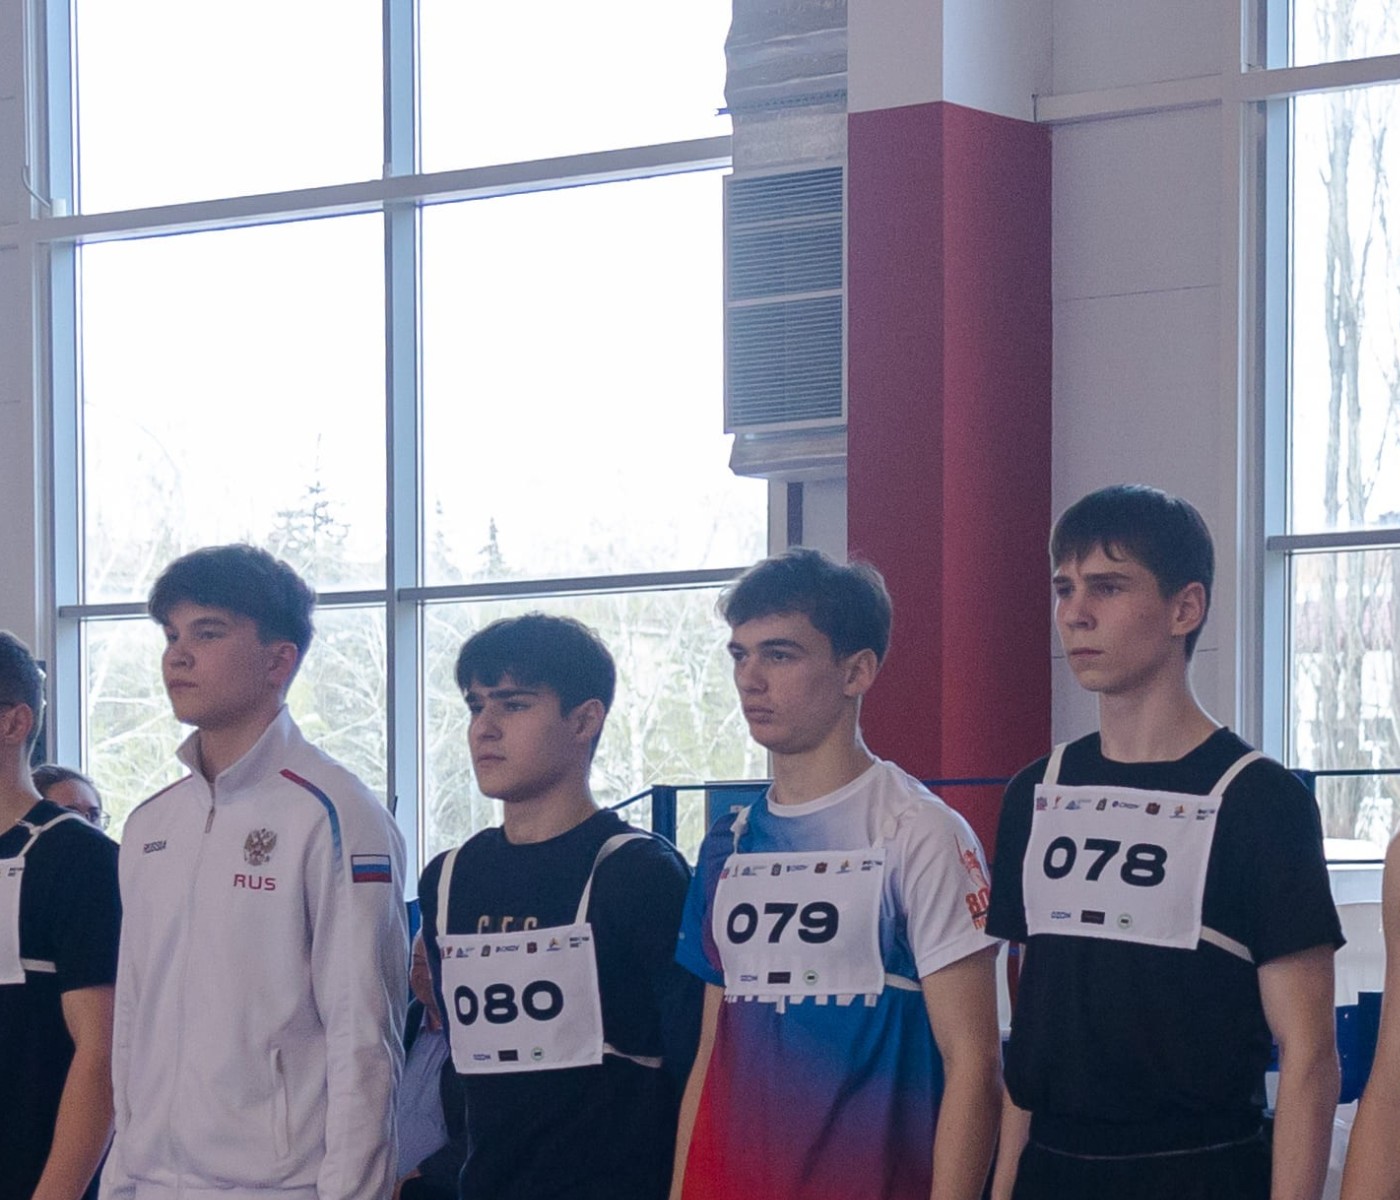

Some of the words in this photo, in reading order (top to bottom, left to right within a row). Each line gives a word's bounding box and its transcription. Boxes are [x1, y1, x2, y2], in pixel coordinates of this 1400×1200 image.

[233, 873, 277, 891] RUS
[1043, 836, 1168, 887] 078
[727, 901, 839, 945] 079
[454, 980, 564, 1026] 080
